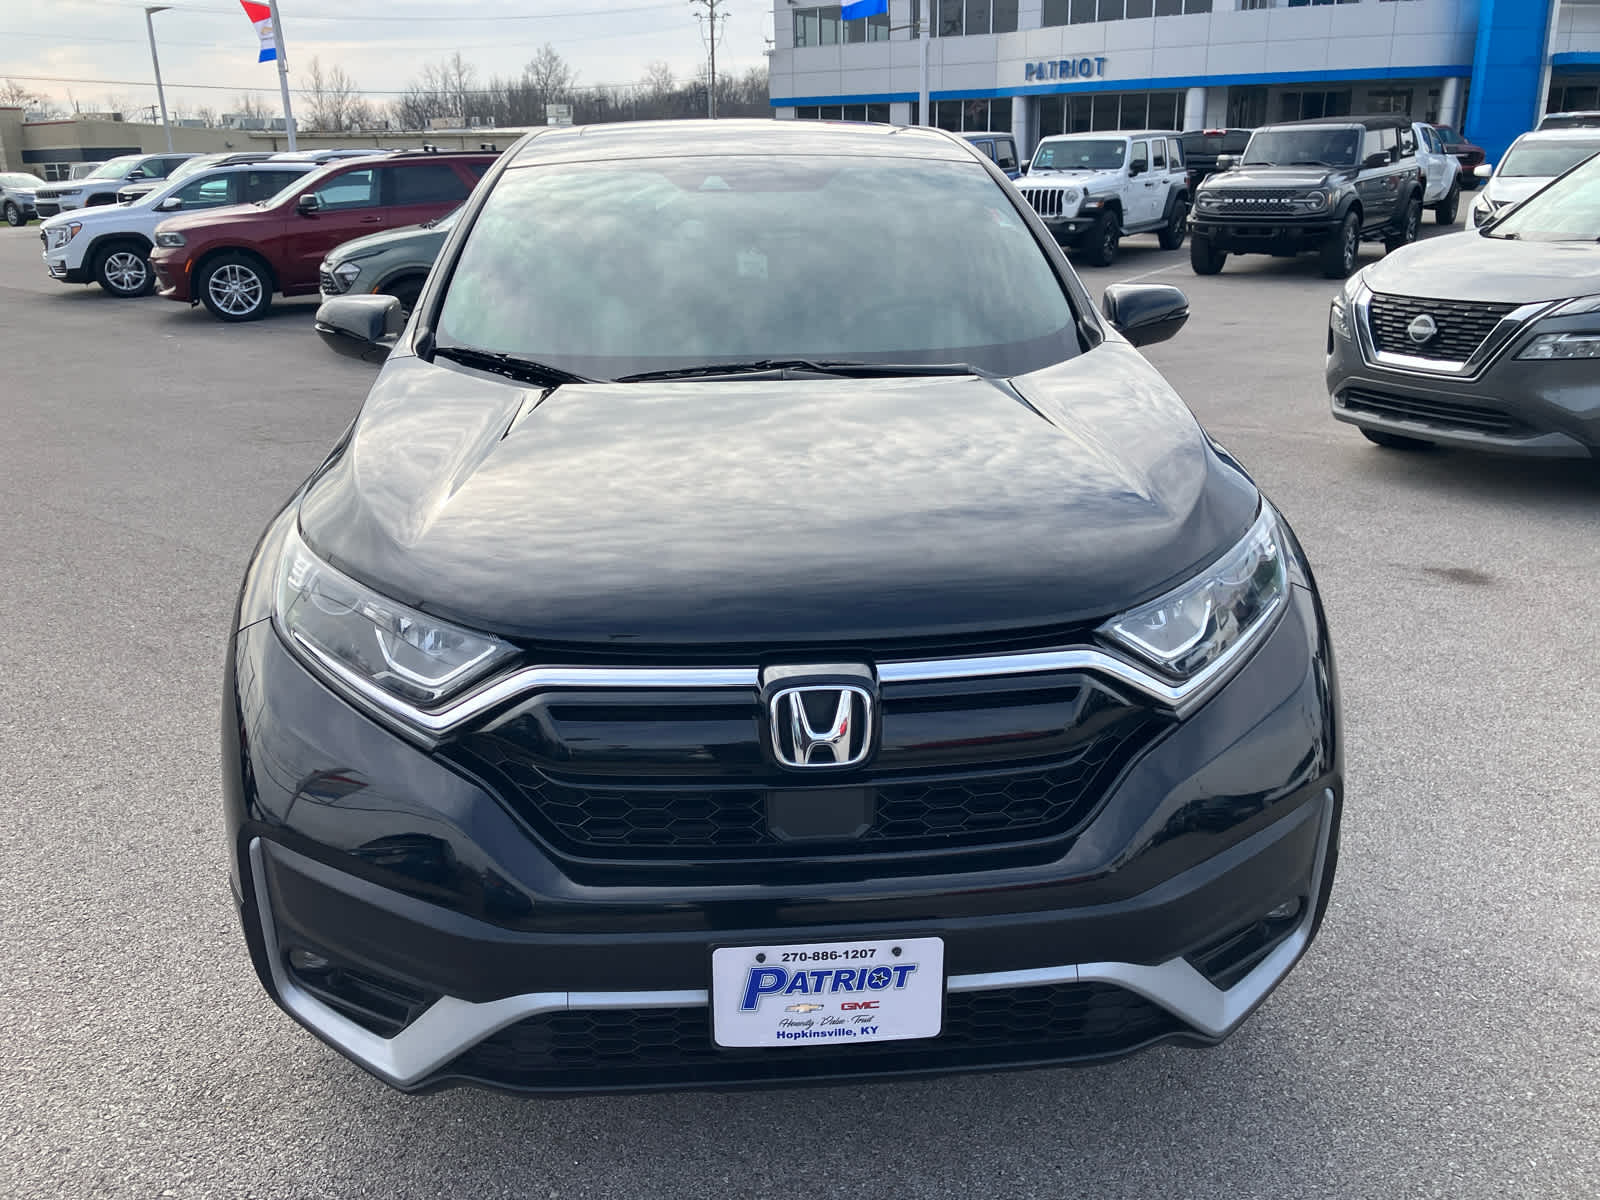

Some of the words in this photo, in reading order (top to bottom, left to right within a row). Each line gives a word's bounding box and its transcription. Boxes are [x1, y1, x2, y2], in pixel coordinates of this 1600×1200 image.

[1025, 57, 1107, 81] PATRIOT
[781, 949, 877, 962] 270-886-1207
[739, 964, 917, 1011] PATRIOT
[840, 1001, 880, 1010] GMC
[776, 1028, 857, 1040] Hopkinsville,
[860, 1026, 879, 1035] KY
